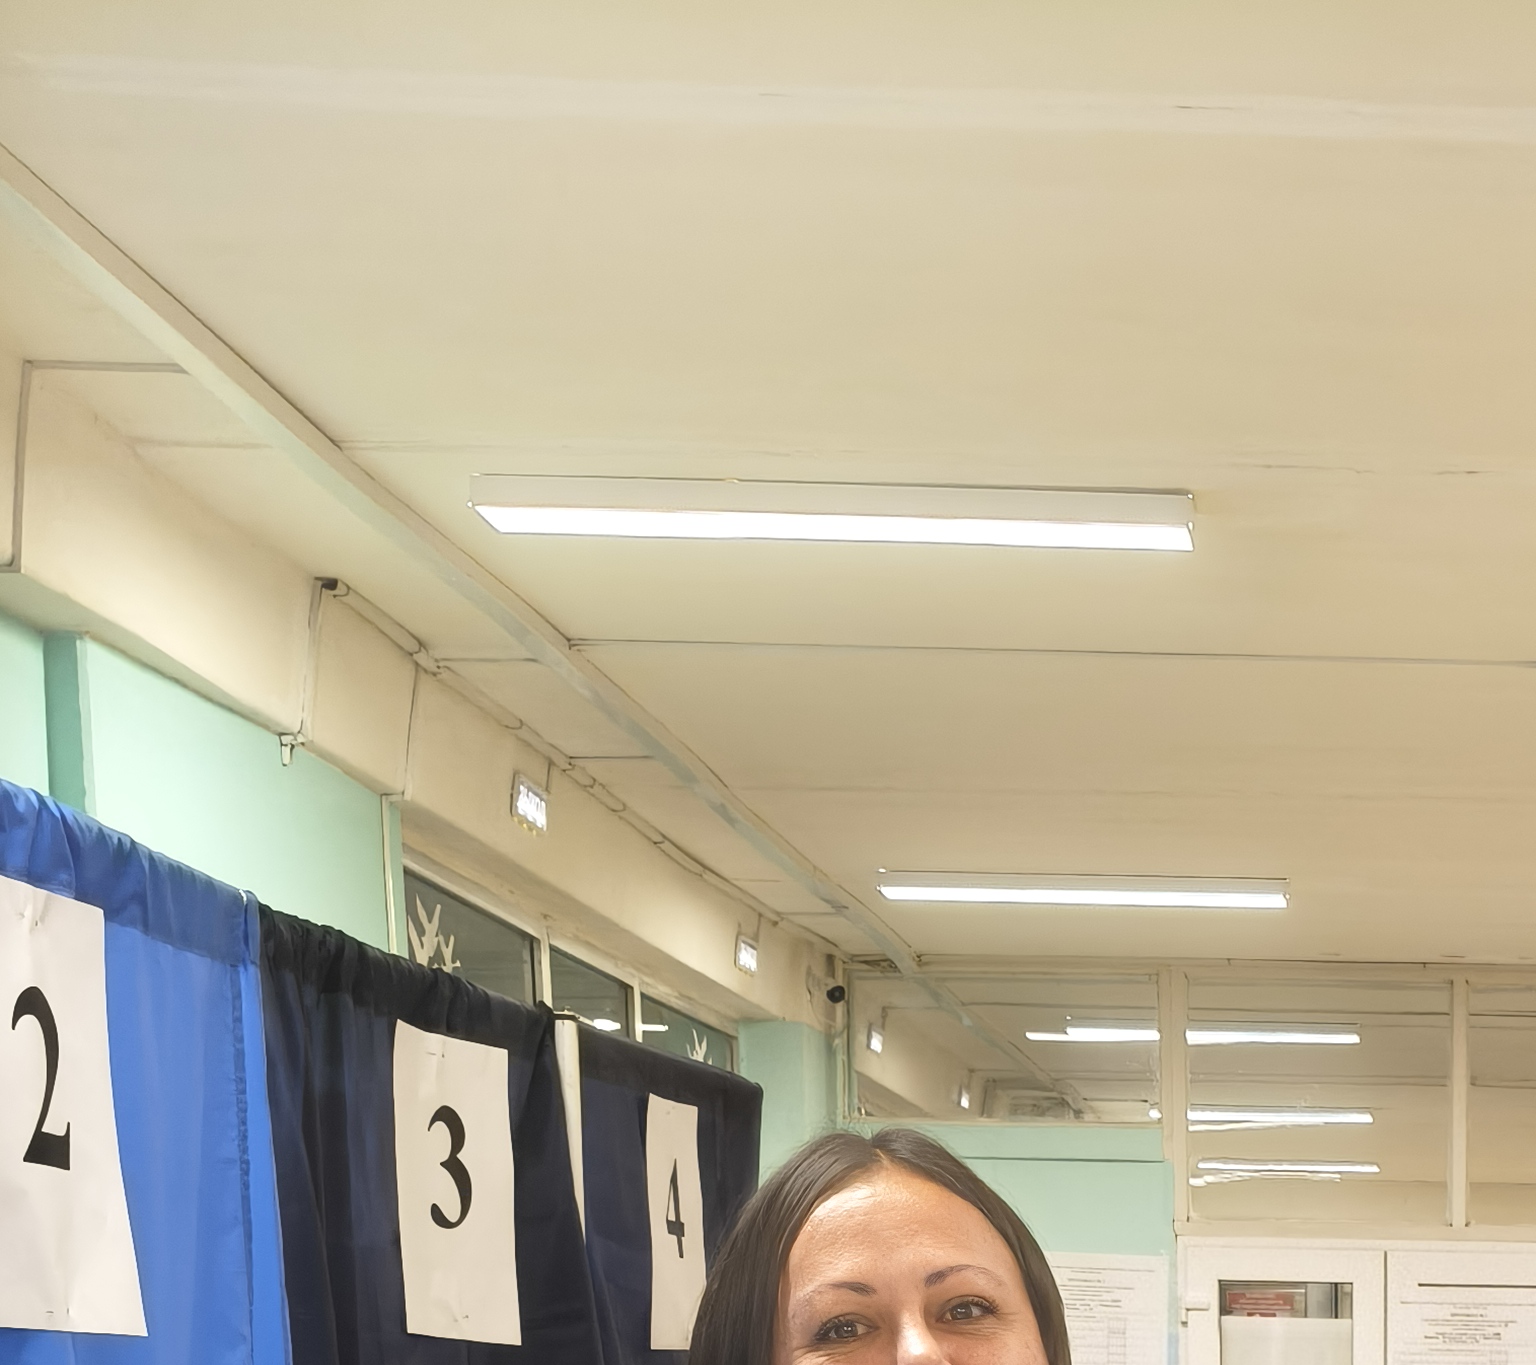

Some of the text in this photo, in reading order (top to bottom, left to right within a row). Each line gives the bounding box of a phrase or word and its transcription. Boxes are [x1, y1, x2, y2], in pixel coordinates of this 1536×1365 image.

[11, 986, 71, 1171] 2
[427, 1105, 473, 1229] 3
[665, 1158, 685, 1259] 4
